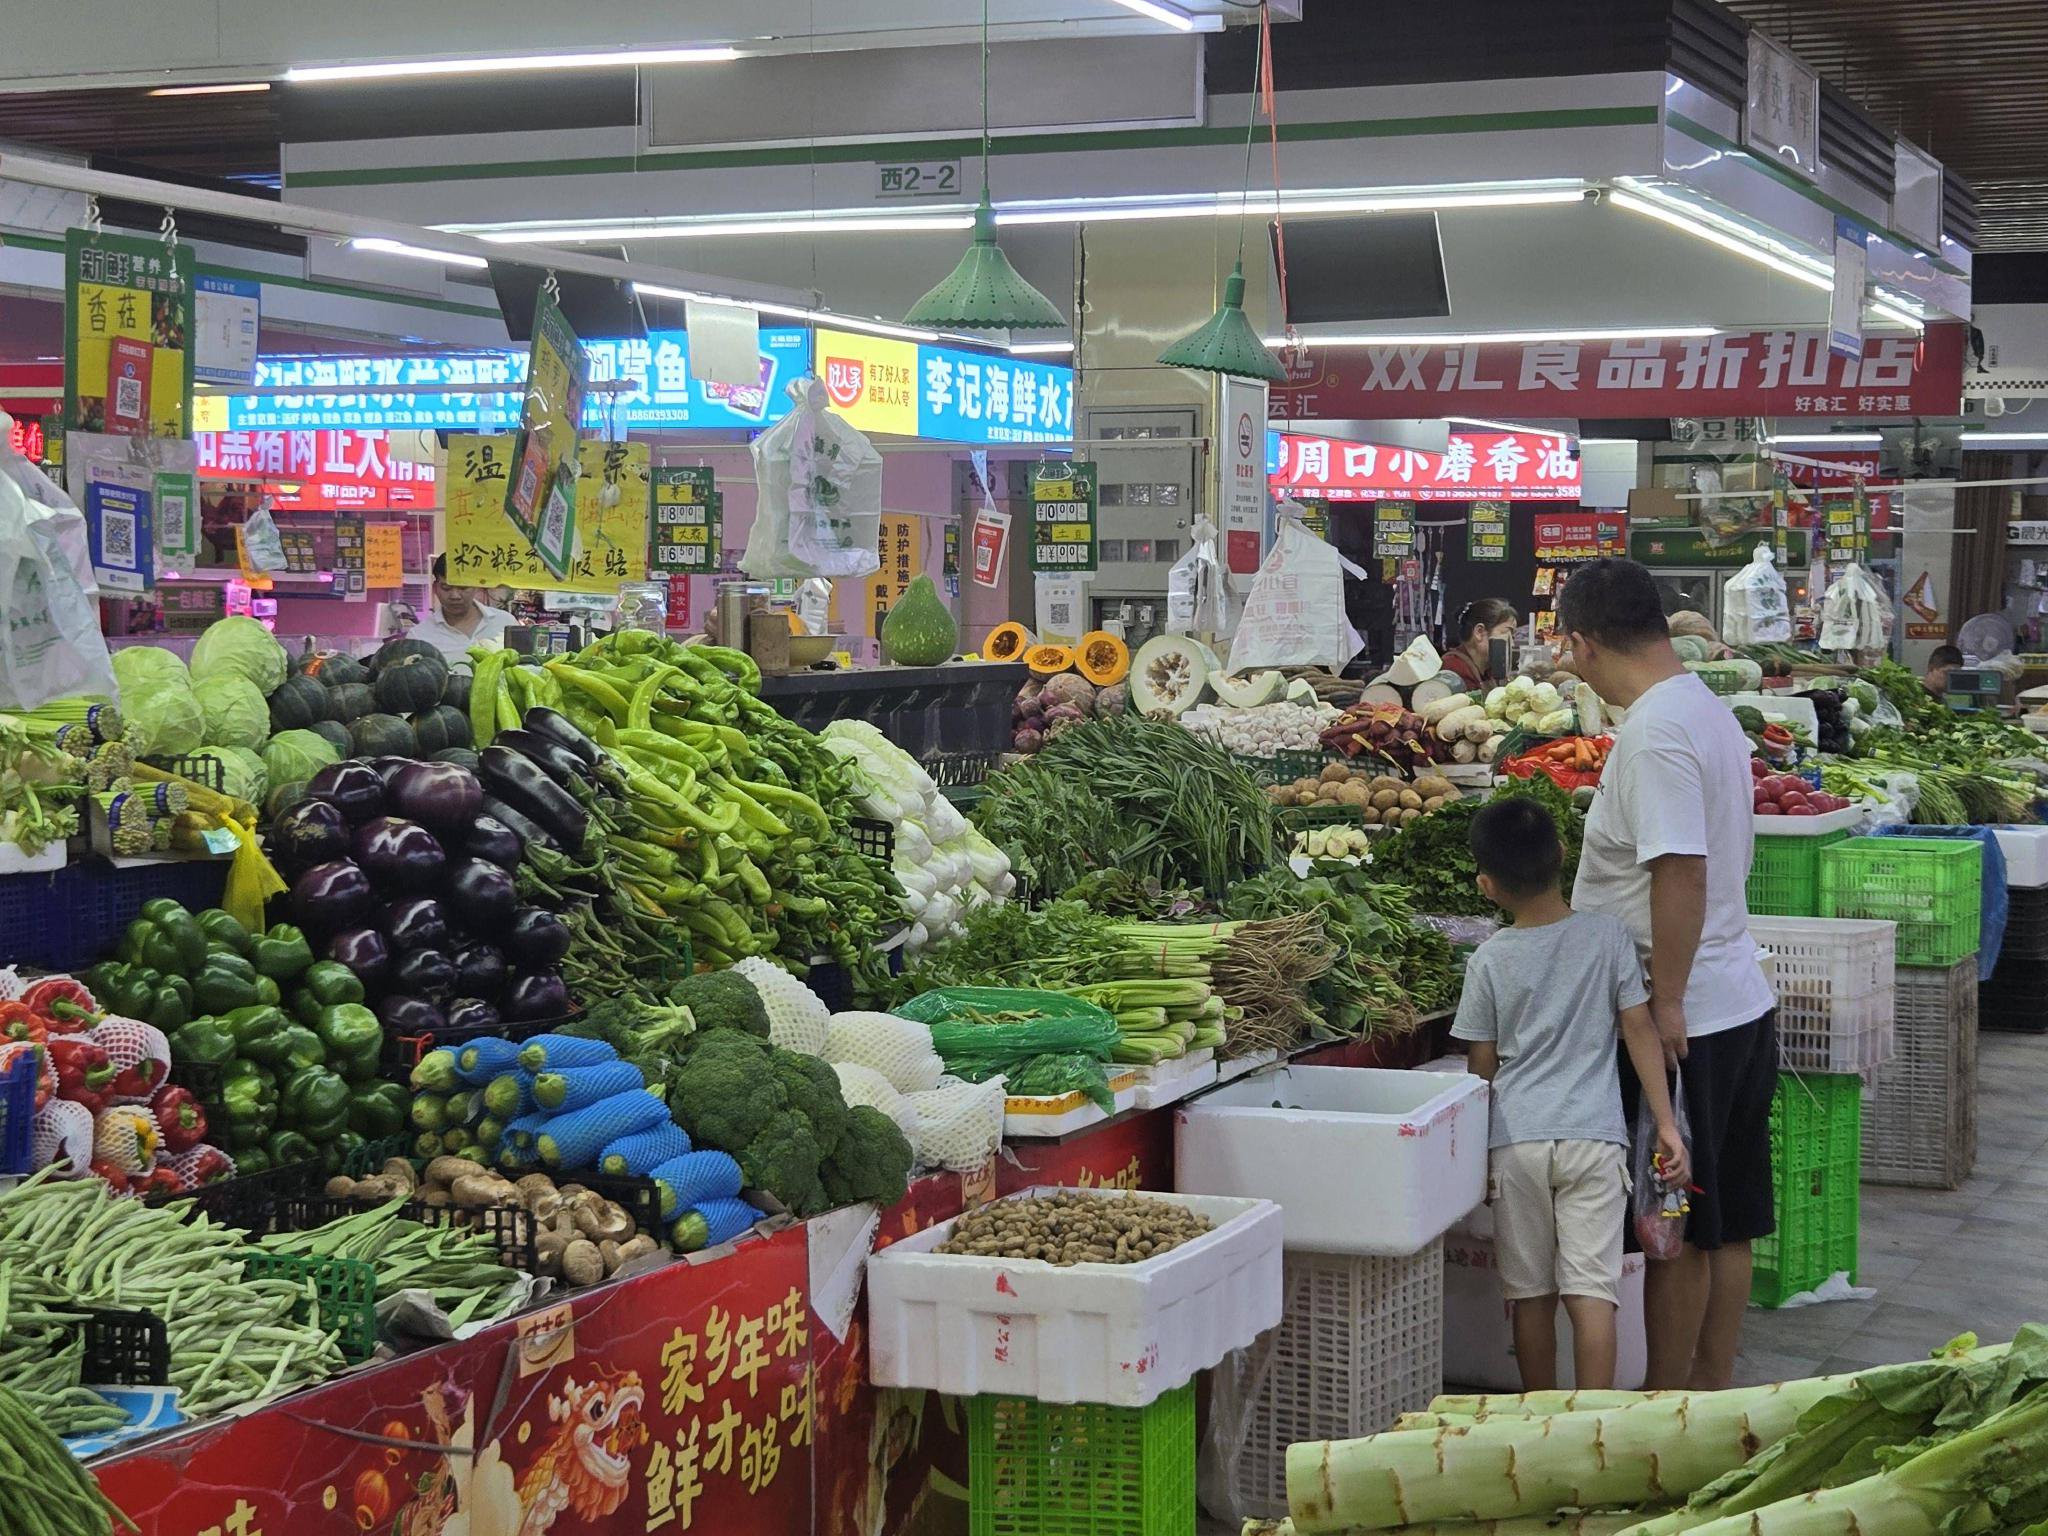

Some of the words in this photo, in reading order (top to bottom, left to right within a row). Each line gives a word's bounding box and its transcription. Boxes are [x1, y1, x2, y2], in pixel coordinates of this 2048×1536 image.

[881, 165, 955, 191] 西2-2
[80, 248, 129, 284] 新鲜
[87, 289, 138, 333] 香菇
[1362, 331, 1913, 392] 双汇食品折扣店
[1795, 395, 1848, 413] 好食汇
[1858, 395, 1911, 413] 好实惠
[1291, 439, 1579, 484] 周口小磨香油
[661, 1286, 809, 1416] 家乡年味
[646, 1361, 818, 1534] 鲜才够味
